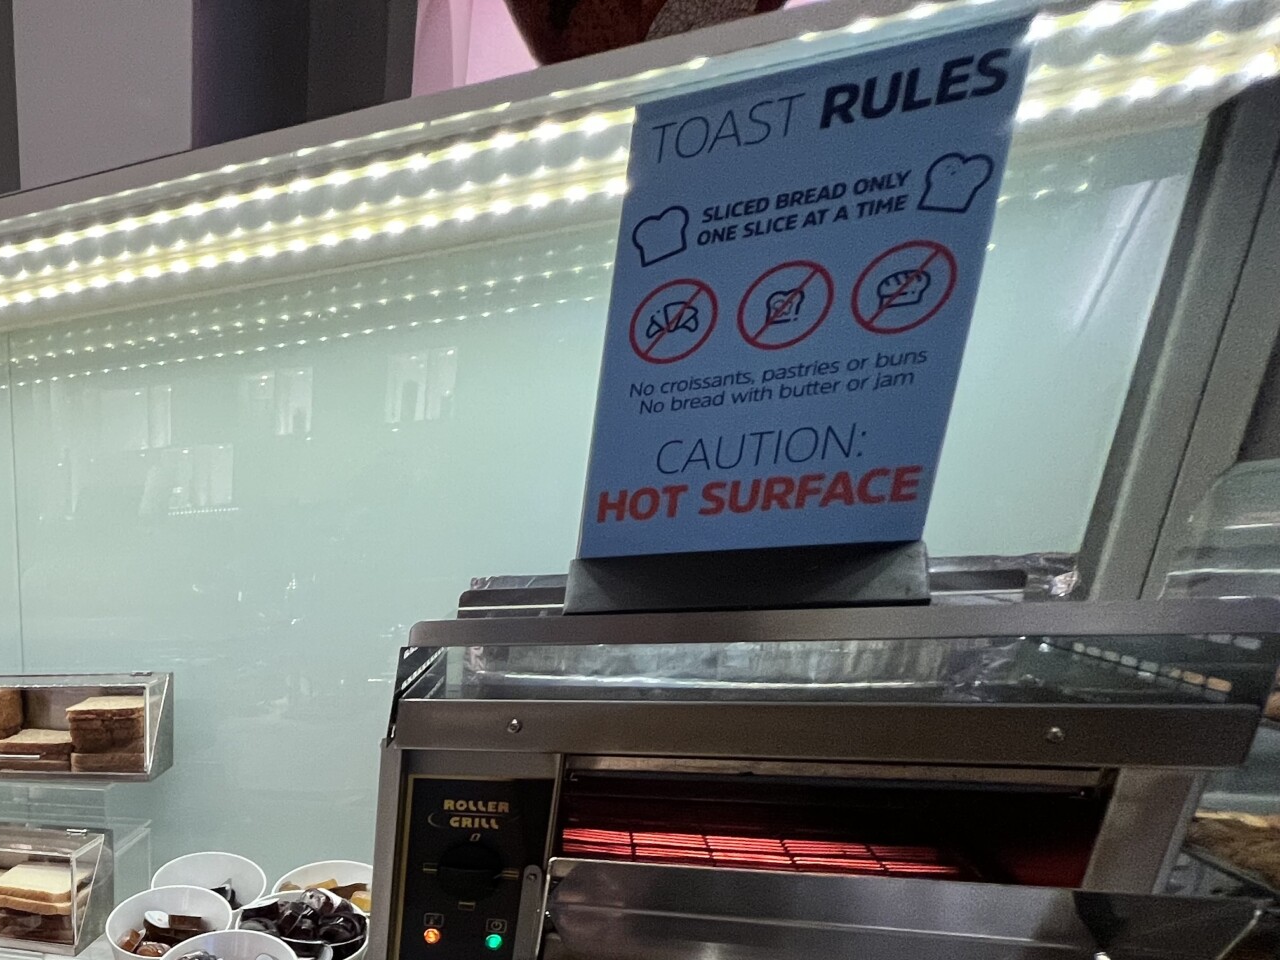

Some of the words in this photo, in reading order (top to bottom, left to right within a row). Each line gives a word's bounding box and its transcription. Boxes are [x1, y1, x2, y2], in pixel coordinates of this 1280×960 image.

[652, 93, 805, 164] TOAST
[819, 48, 1012, 130] RULES
[696, 225, 737, 246] ONE
[742, 214, 797, 239] SLICE
[803, 207, 828, 227] AT
[832, 205, 849, 222] A
[857, 194, 909, 219] TIME
[701, 196, 769, 223] SLICED
[776, 182, 847, 210] BREAD
[853, 169, 912, 194] ONLY
[630, 382, 655, 398] No
[660, 370, 756, 395] croissants,
[762, 360, 840, 385] pastries
[847, 356, 871, 370] or
[875, 348, 928, 368] buns
[638, 399, 665, 415] No
[670, 390, 726, 412] bread
[730, 383, 773, 404] with
[778, 377, 842, 400] butter
[847, 376, 870, 391] or
[872, 370, 915, 391] jam
[655, 422, 868, 475] CAUTION:
[596, 484, 689, 523] HOT
[698, 464, 924, 517] SURFACE
[443, 799, 510, 813] ROLLER
[449, 816, 499, 830] GRILL
